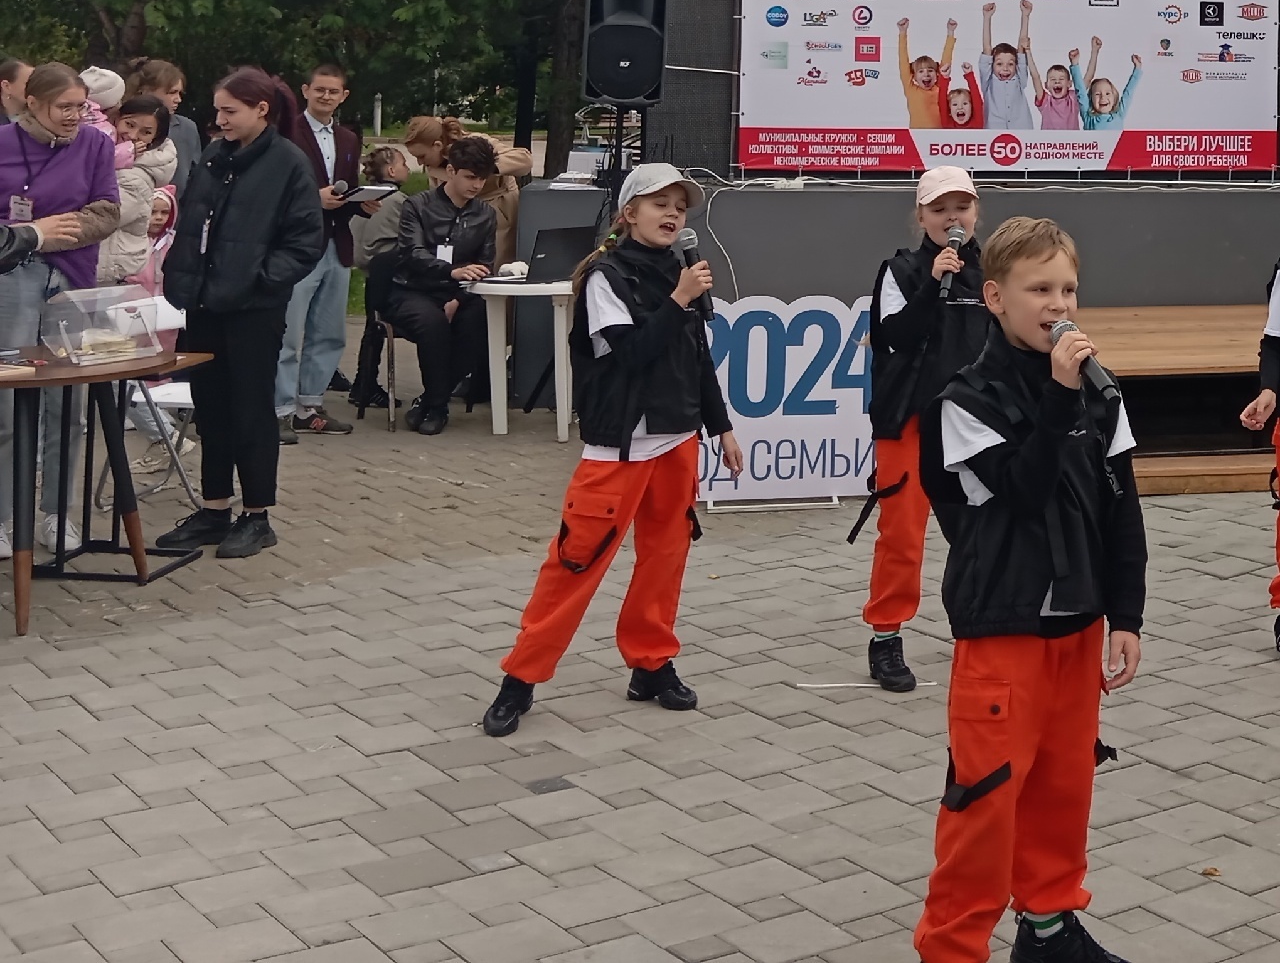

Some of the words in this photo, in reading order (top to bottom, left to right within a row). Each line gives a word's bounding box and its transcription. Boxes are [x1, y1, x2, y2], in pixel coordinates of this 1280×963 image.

[758, 133, 824, 143] МУНИЦИПАЛЬНЫЕ
[825, 133, 857, 143] КРУЖКИ
[867, 133, 895, 143] СЕКЦИИ
[1025, 141, 1099, 151] НАПРАВЛЕНИЙ
[1146, 135, 1197, 152] ВЫБЕРИ
[1200, 135, 1253, 152] ЛУЧШЕЕ
[748, 144, 799, 154] КОЛЛЕКТИВЫ
[808, 145, 865, 154] КОММЕРЧЕСКИЕ
[866, 145, 905, 154] КОМПАНИИ
[929, 143, 987, 156] БОЛЕЕ
[992, 142, 1021, 159] 50
[773, 156, 839, 166] НЕКОММЕРЧЕСКИЕ
[840, 157, 879, 166] КОМПАНИИ
[1025, 151, 1031, 159] В
[1034, 152, 1070, 161] ОДНОМ
[1072, 151, 1105, 160] МЕСТЕ
[1151, 155, 1171, 167] ДЛЯ
[1172, 155, 1205, 167] СВОЕГО
[1206, 155, 1248, 167] РЕБЕНКА!
[750, 438, 875, 482] семьи
